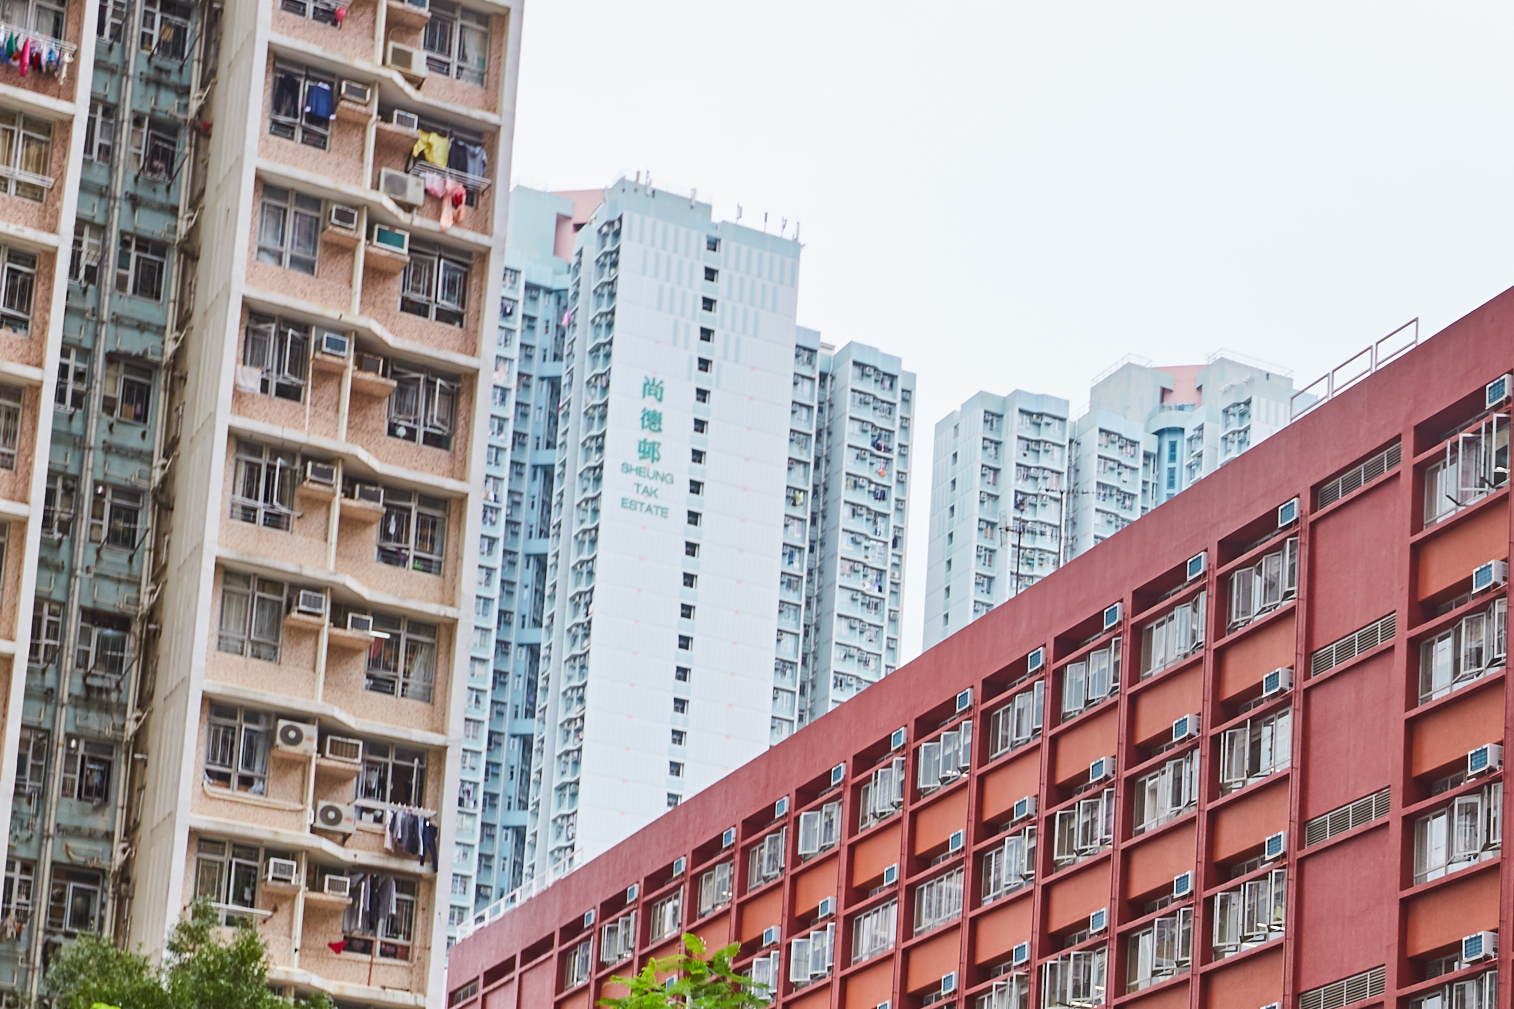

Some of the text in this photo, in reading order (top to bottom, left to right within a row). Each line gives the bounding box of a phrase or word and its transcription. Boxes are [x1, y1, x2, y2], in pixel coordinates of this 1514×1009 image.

[637, 376, 664, 463] 尚德邨
[620, 462, 674, 484] SHEUNG
[634, 482, 659, 499] TAK
[620, 497, 670, 519] ESTATE
